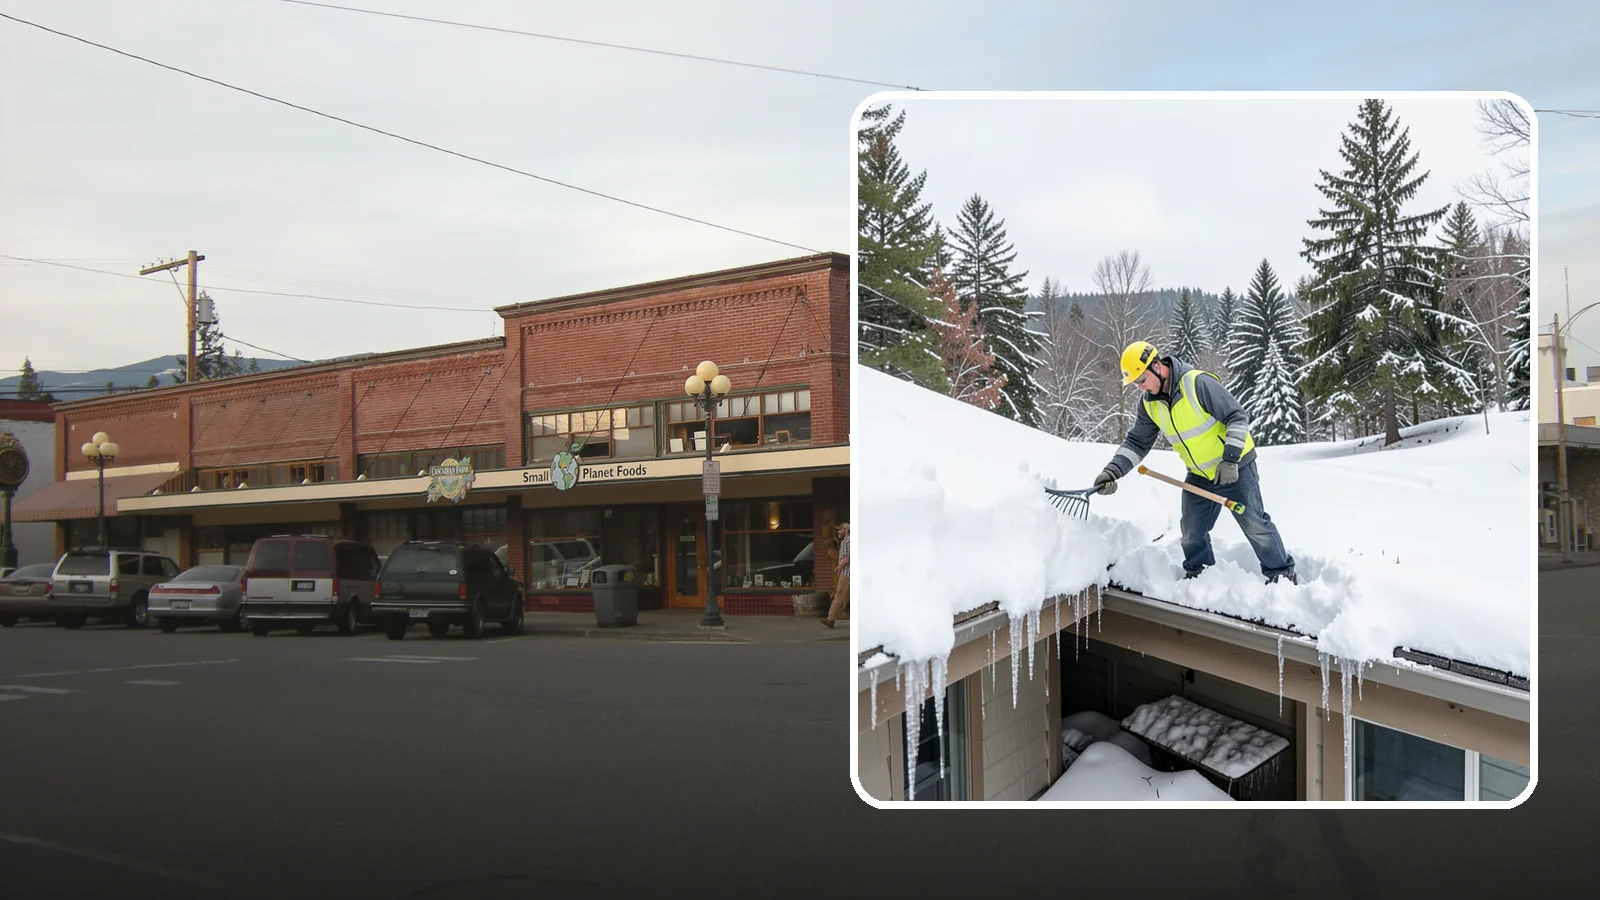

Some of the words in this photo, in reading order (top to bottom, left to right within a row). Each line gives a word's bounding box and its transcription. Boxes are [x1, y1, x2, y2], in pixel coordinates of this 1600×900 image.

[431, 466, 456, 476] CASCADIAN
[523, 471, 549, 483] Small
[583, 467, 614, 479] Planet
[617, 464, 647, 477] Foods
